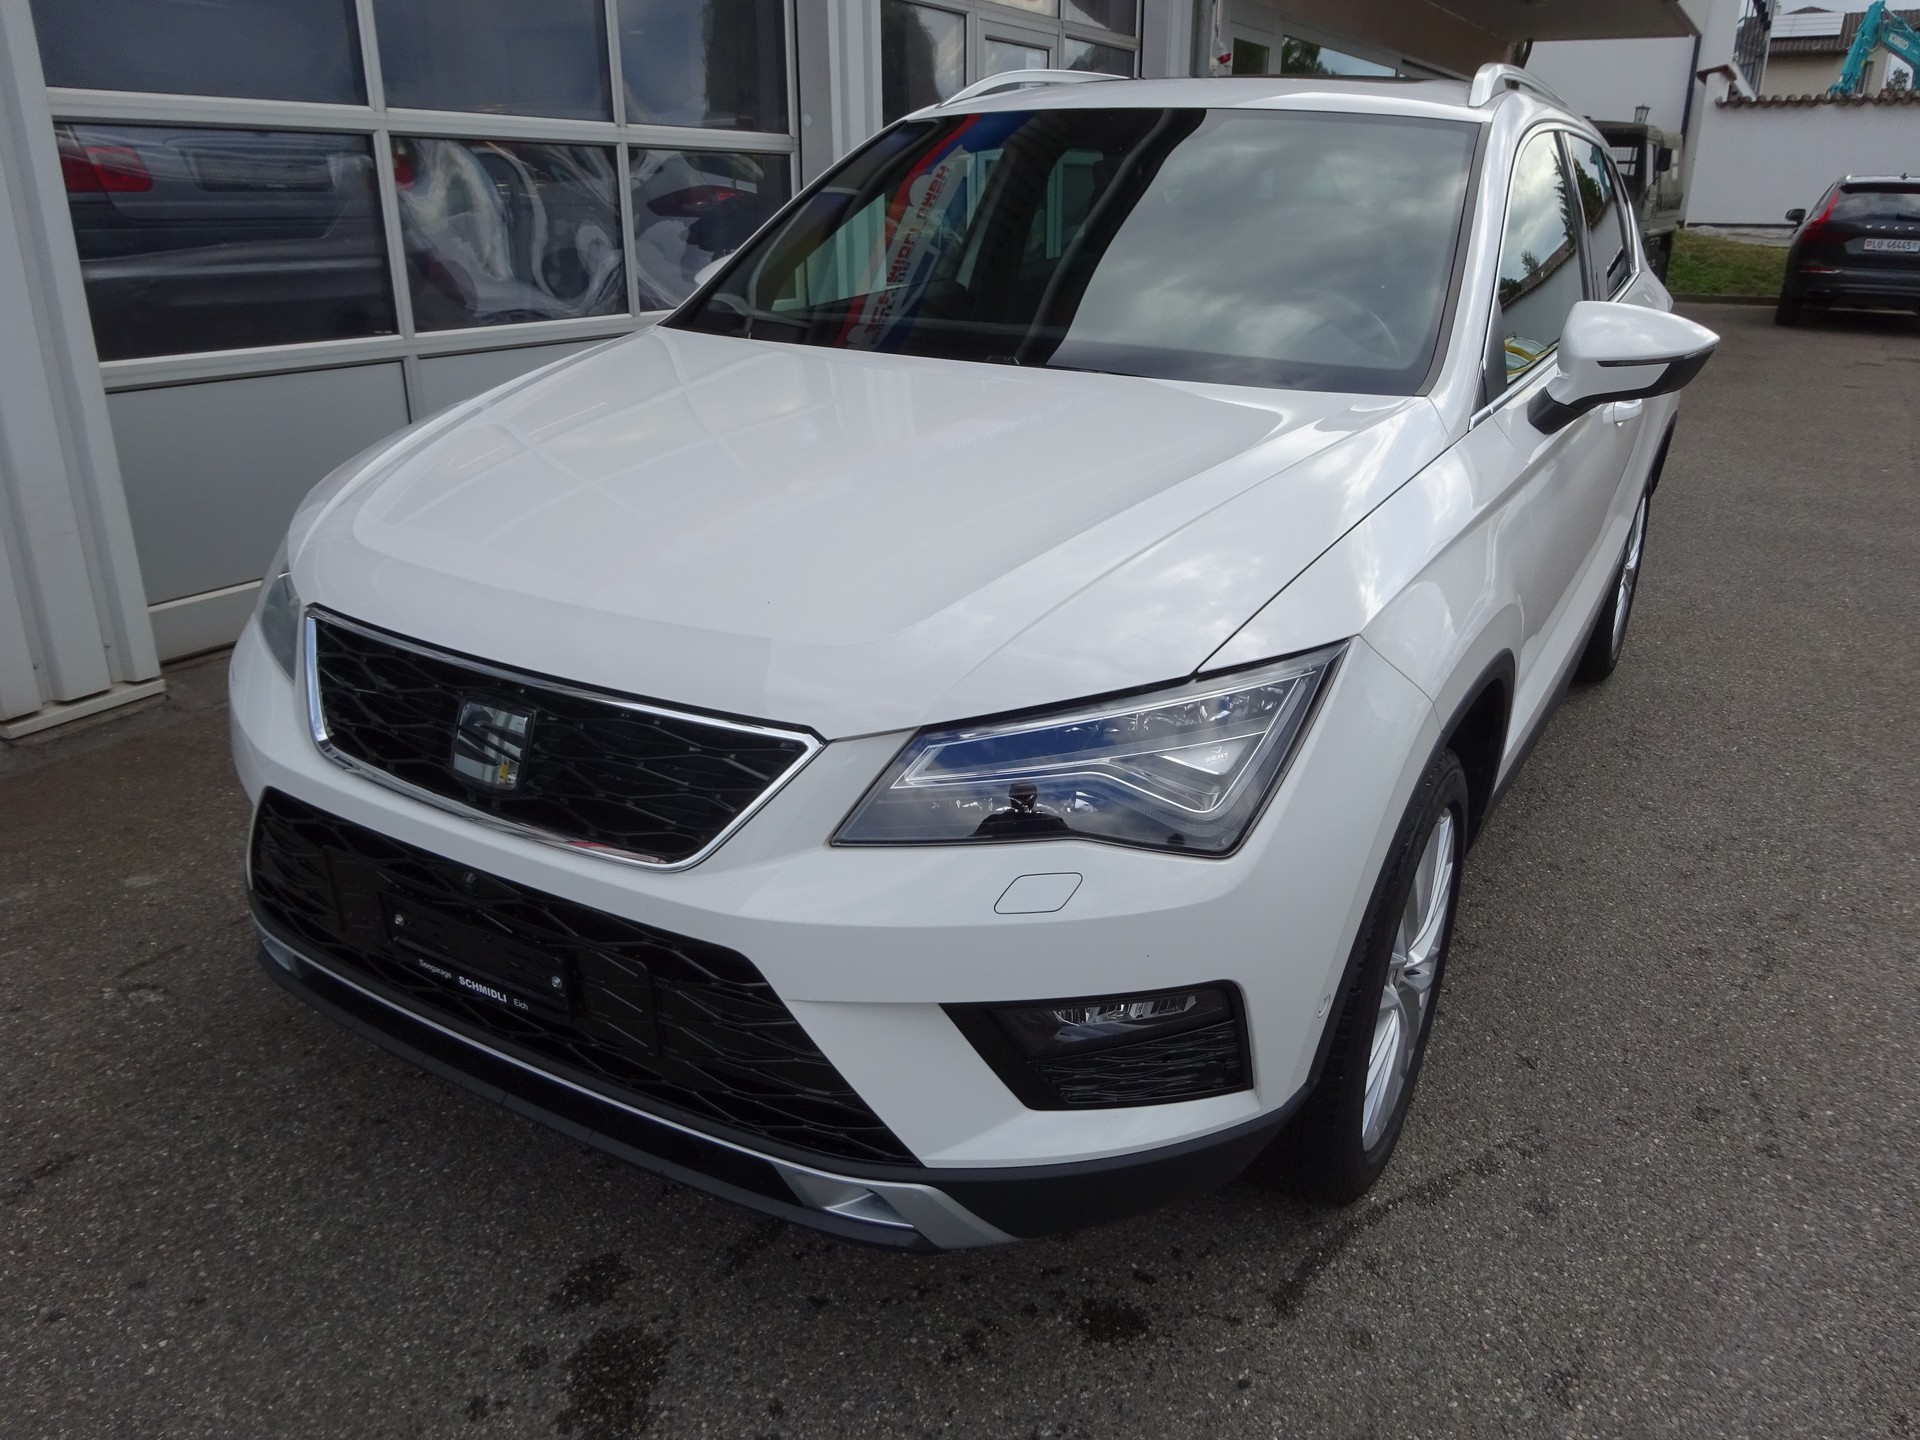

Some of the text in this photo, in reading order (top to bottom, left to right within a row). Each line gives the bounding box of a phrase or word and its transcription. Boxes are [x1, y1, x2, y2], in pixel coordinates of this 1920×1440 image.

[1205, 752, 1229, 762] SEAT
[418, 958, 529, 1010] Seegarage SCHMIDLI Eich
